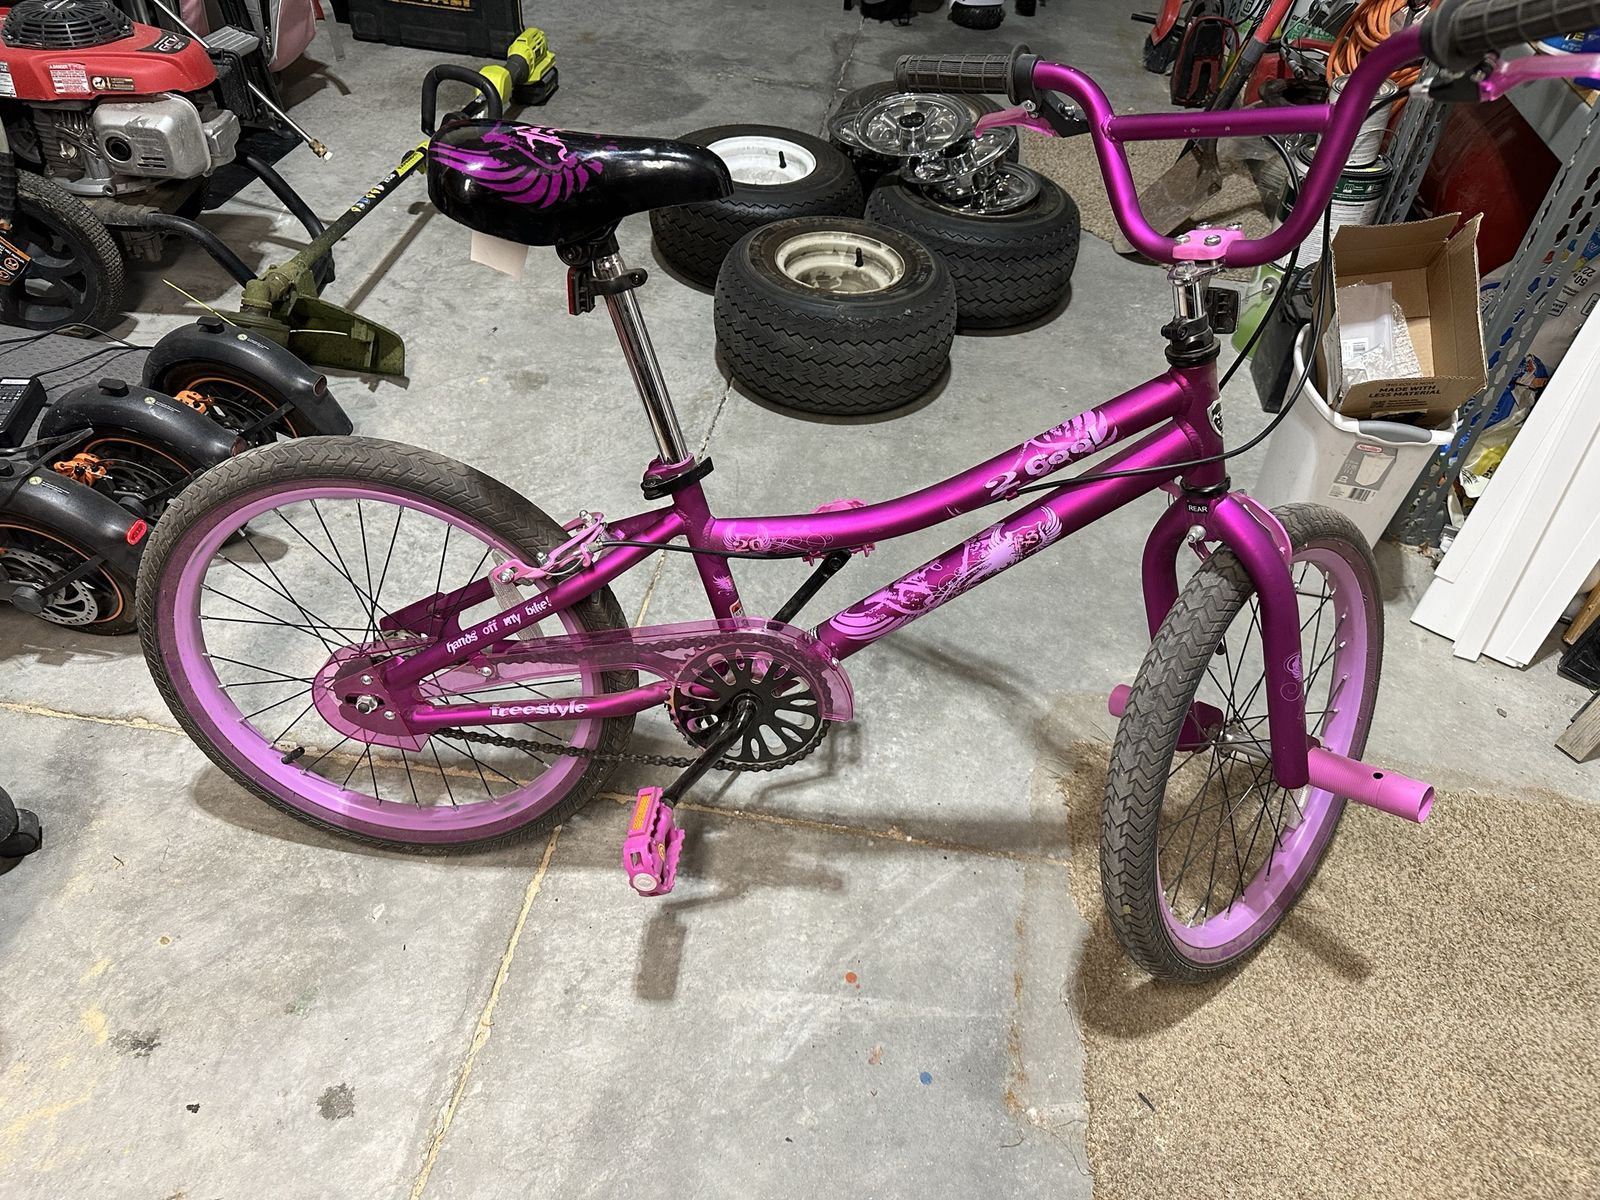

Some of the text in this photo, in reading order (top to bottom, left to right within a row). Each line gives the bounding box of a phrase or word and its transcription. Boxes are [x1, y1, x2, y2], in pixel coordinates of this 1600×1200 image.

[159, 34, 181, 51] GCV
[1574, 275, 1588, 286] 50
[983, 471, 1020, 497] 2
[1188, 504, 1208, 513] REAR
[446, 595, 552, 655] hands off my bike!
[489, 700, 589, 717] freestyle
